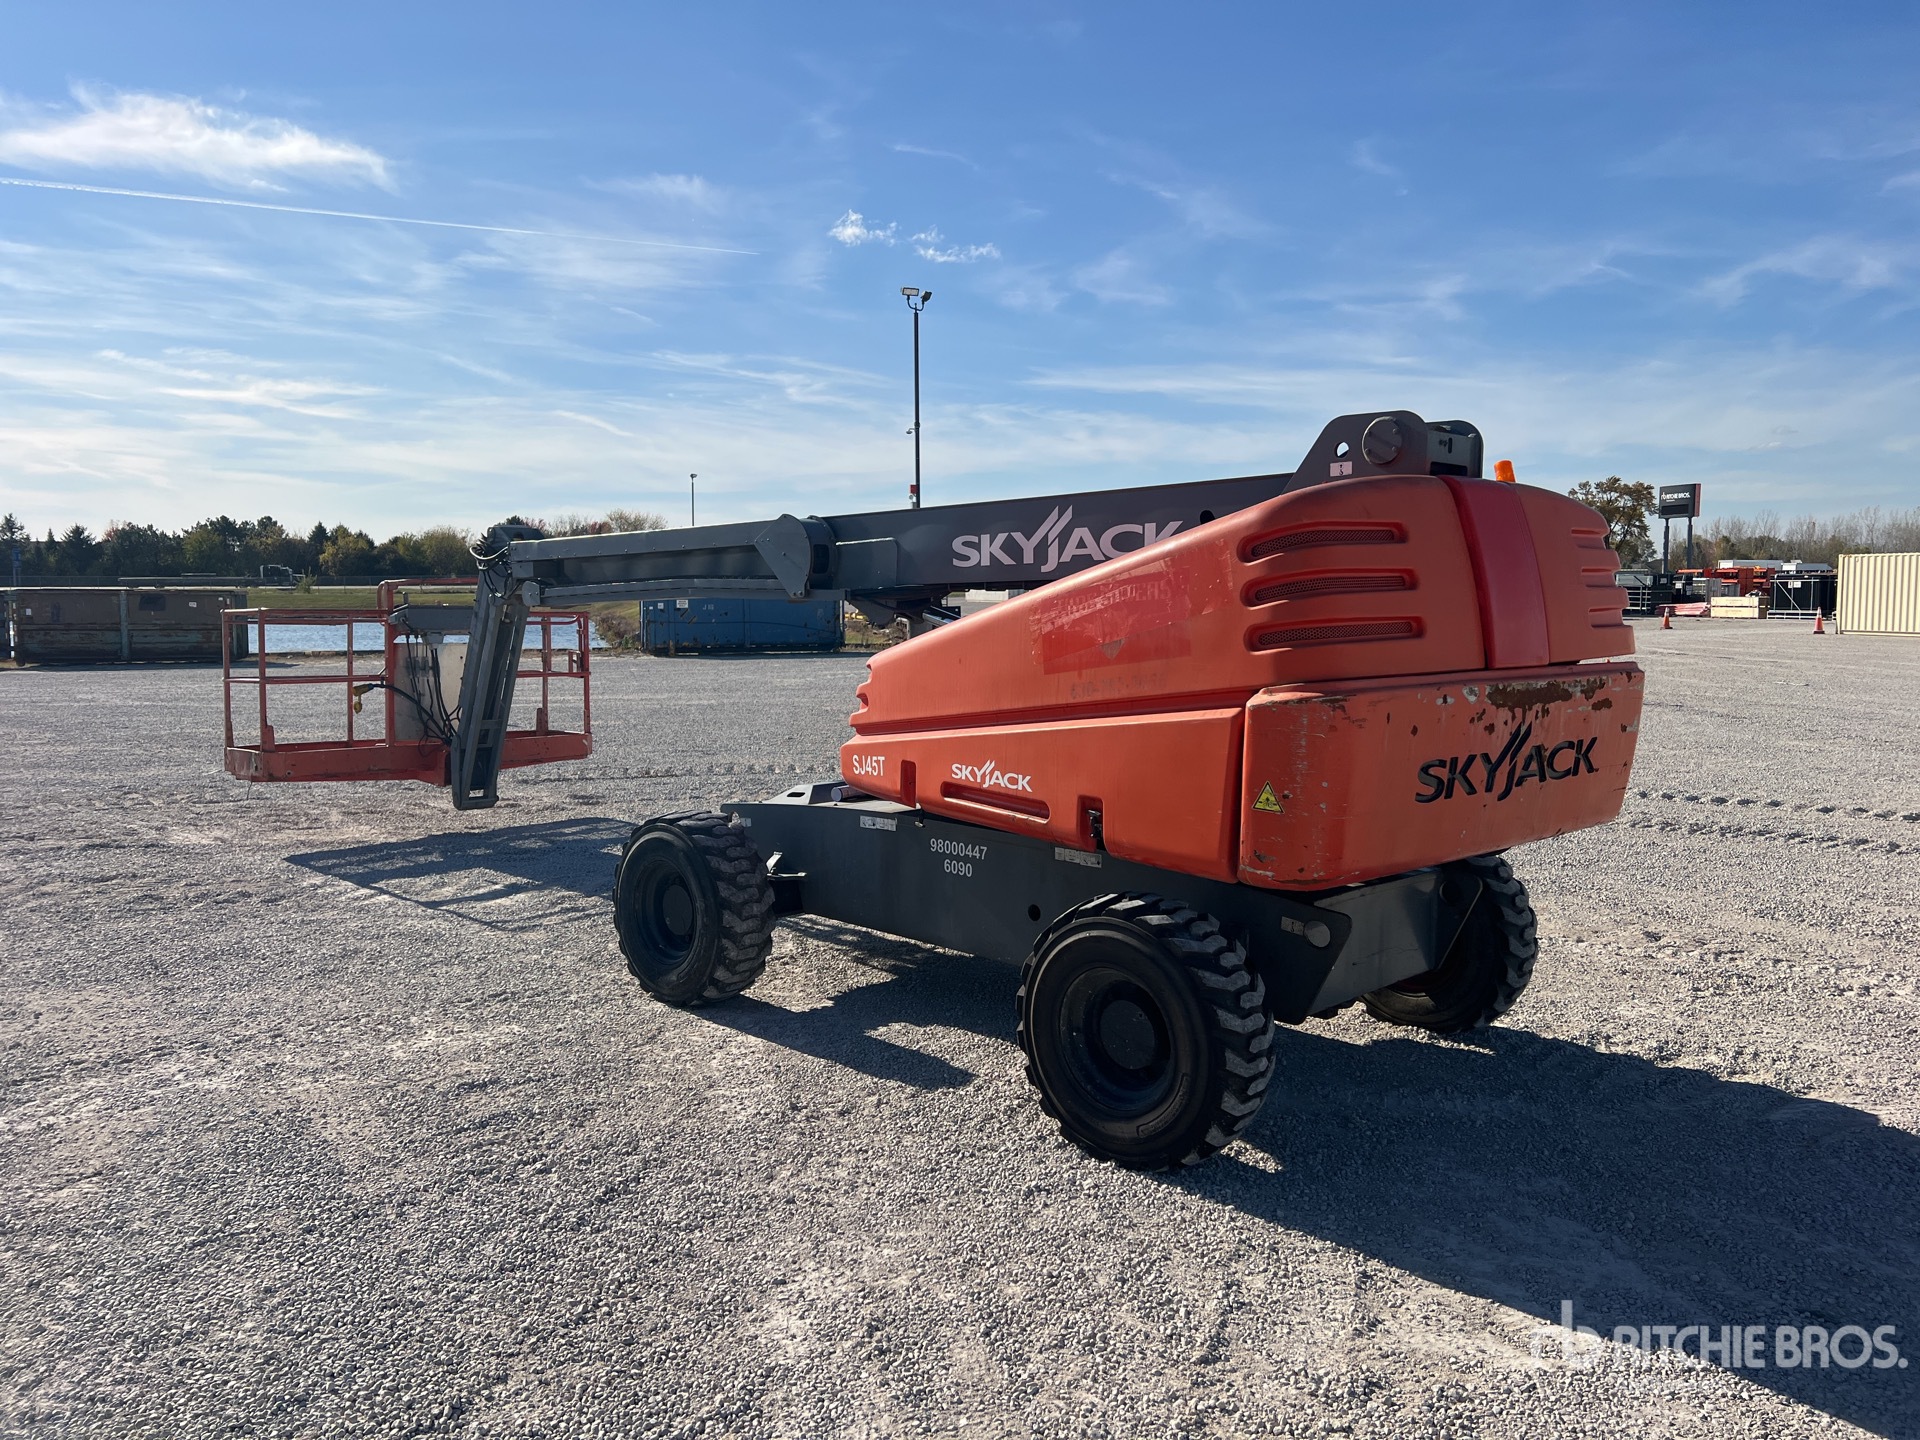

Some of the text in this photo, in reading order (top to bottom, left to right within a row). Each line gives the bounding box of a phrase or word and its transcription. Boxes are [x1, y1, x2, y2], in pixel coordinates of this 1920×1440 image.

[952, 504, 1184, 573] SKYJACK
[853, 754, 885, 777] SJ45T
[951, 759, 1032, 792] SKYJACK
[1414, 720, 1599, 804] SKYJACK
[929, 838, 988, 860] 98000447
[944, 859, 973, 878] 6090
